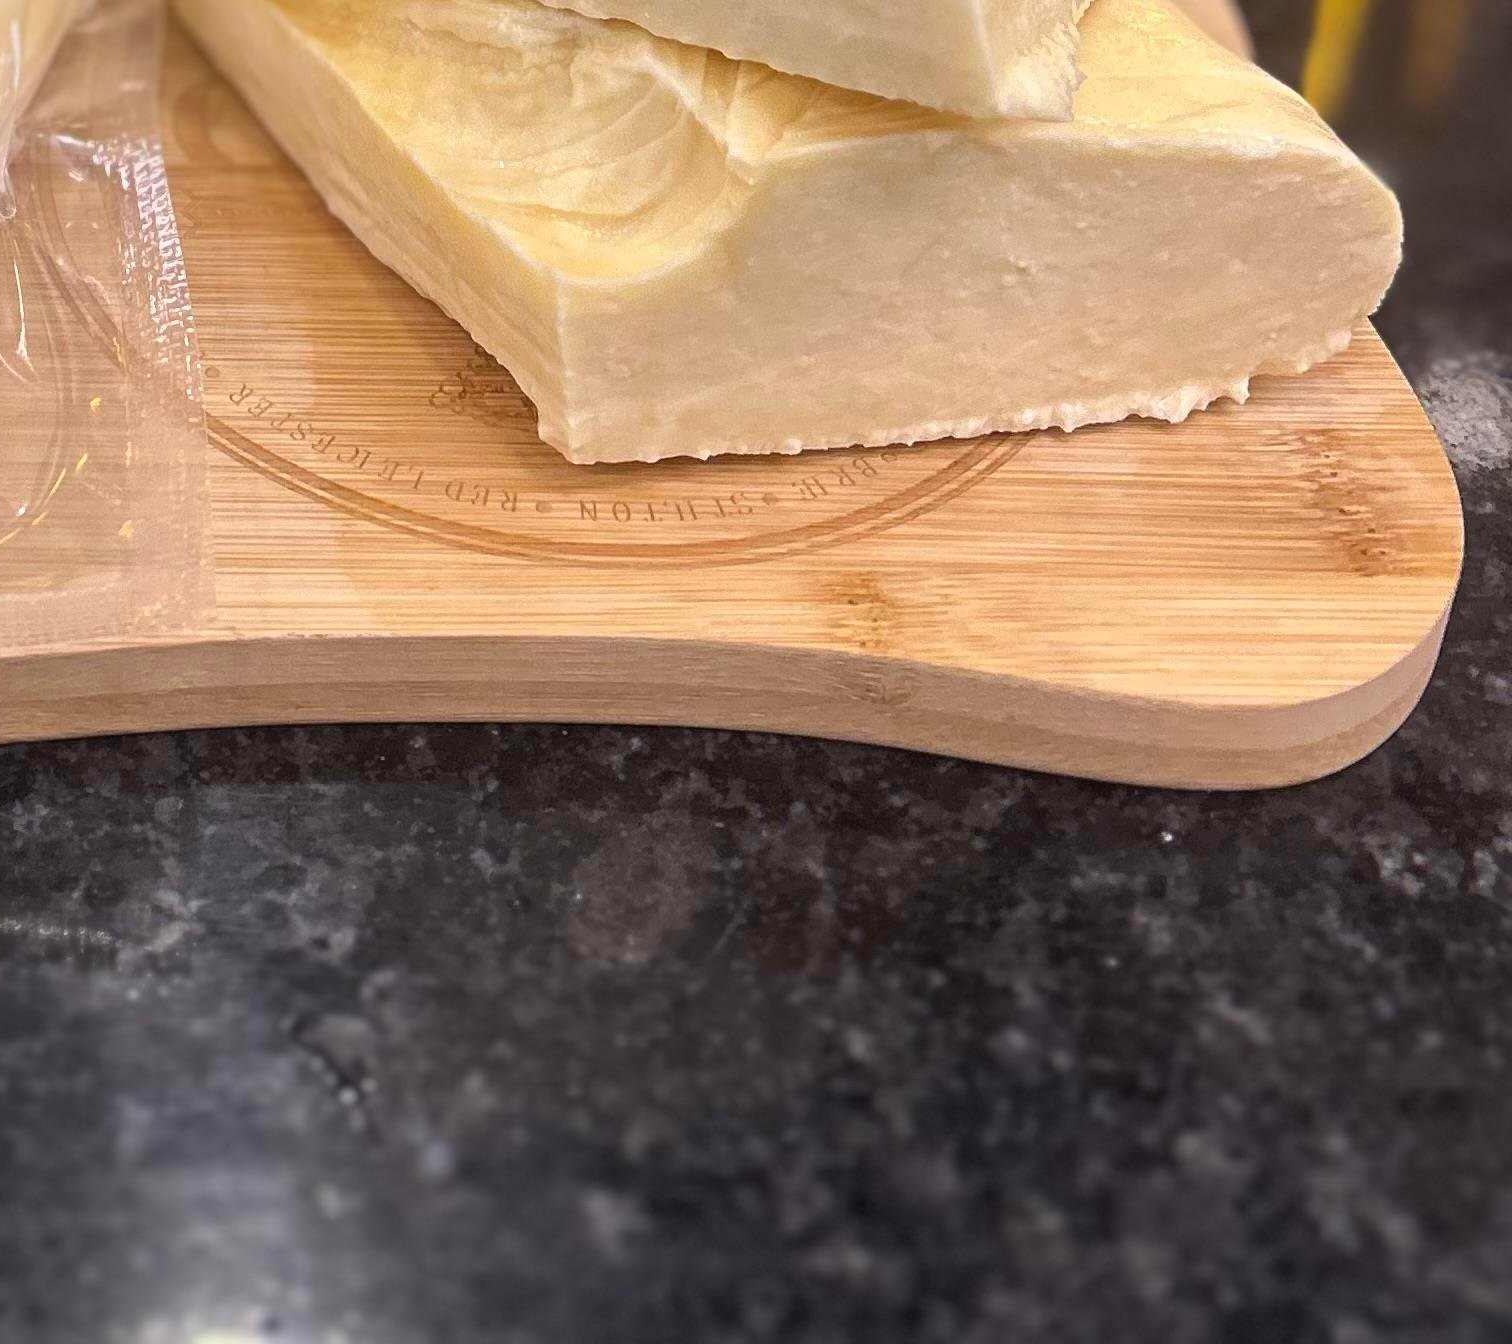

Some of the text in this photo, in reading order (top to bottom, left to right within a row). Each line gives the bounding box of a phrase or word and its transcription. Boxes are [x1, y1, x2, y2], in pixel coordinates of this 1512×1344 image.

[229, 383, 879, 523] BRIE STILTON RED LEICESTER
